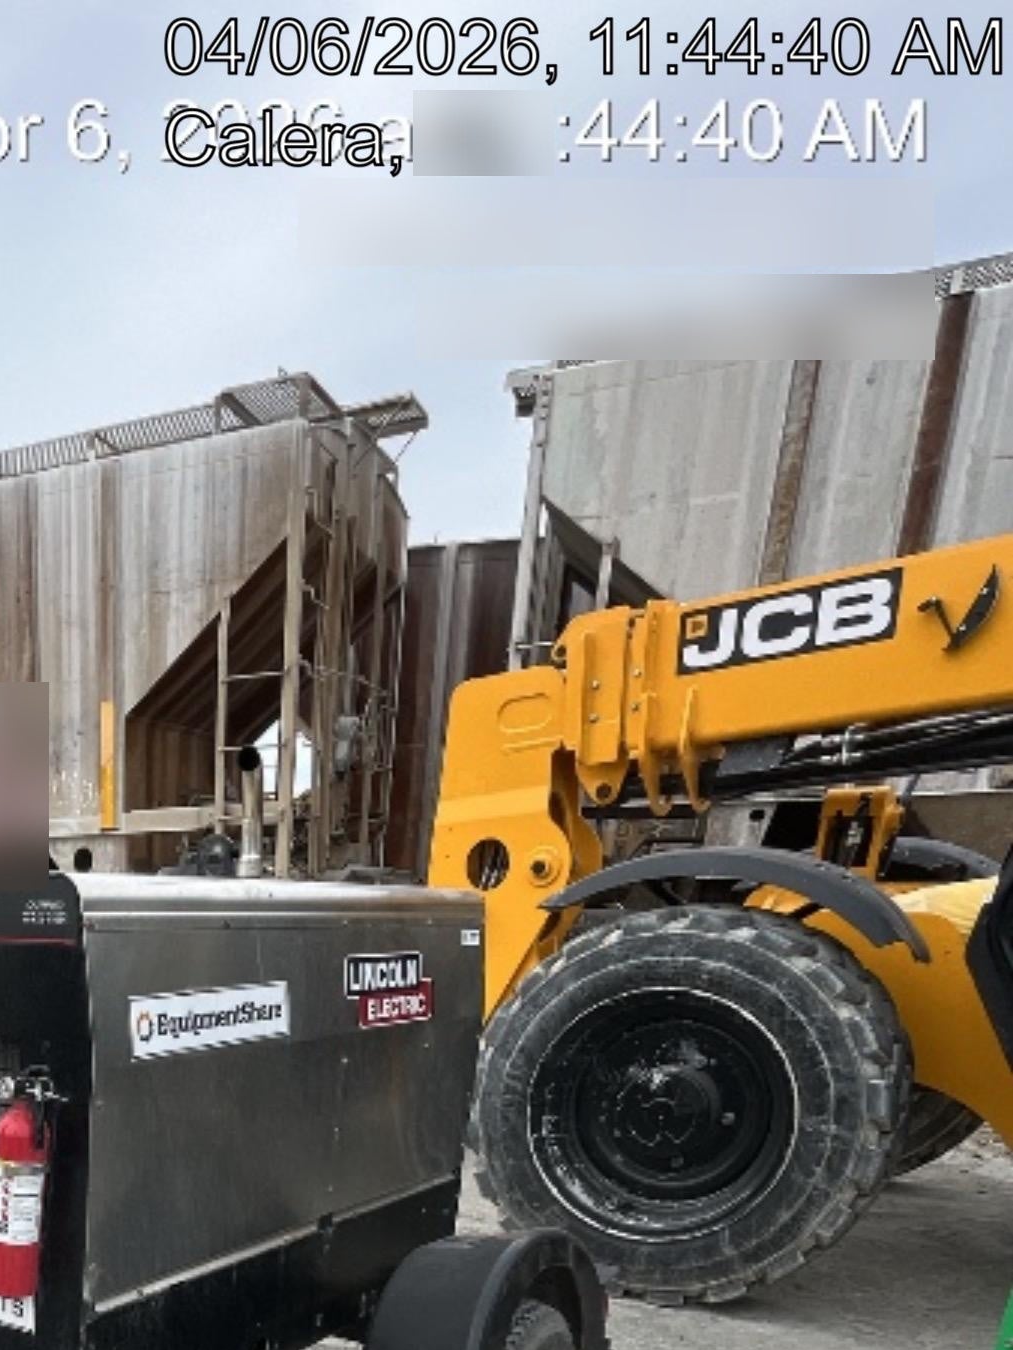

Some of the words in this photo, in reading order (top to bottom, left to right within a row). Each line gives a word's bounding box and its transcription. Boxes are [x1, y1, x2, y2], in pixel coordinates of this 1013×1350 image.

[681, 576, 894, 669] JCB
[349, 958, 418, 991] LINCOLN
[157, 1001, 283, 1039] EquipmentShare
[367, 993, 426, 1021] ELECTRIC
